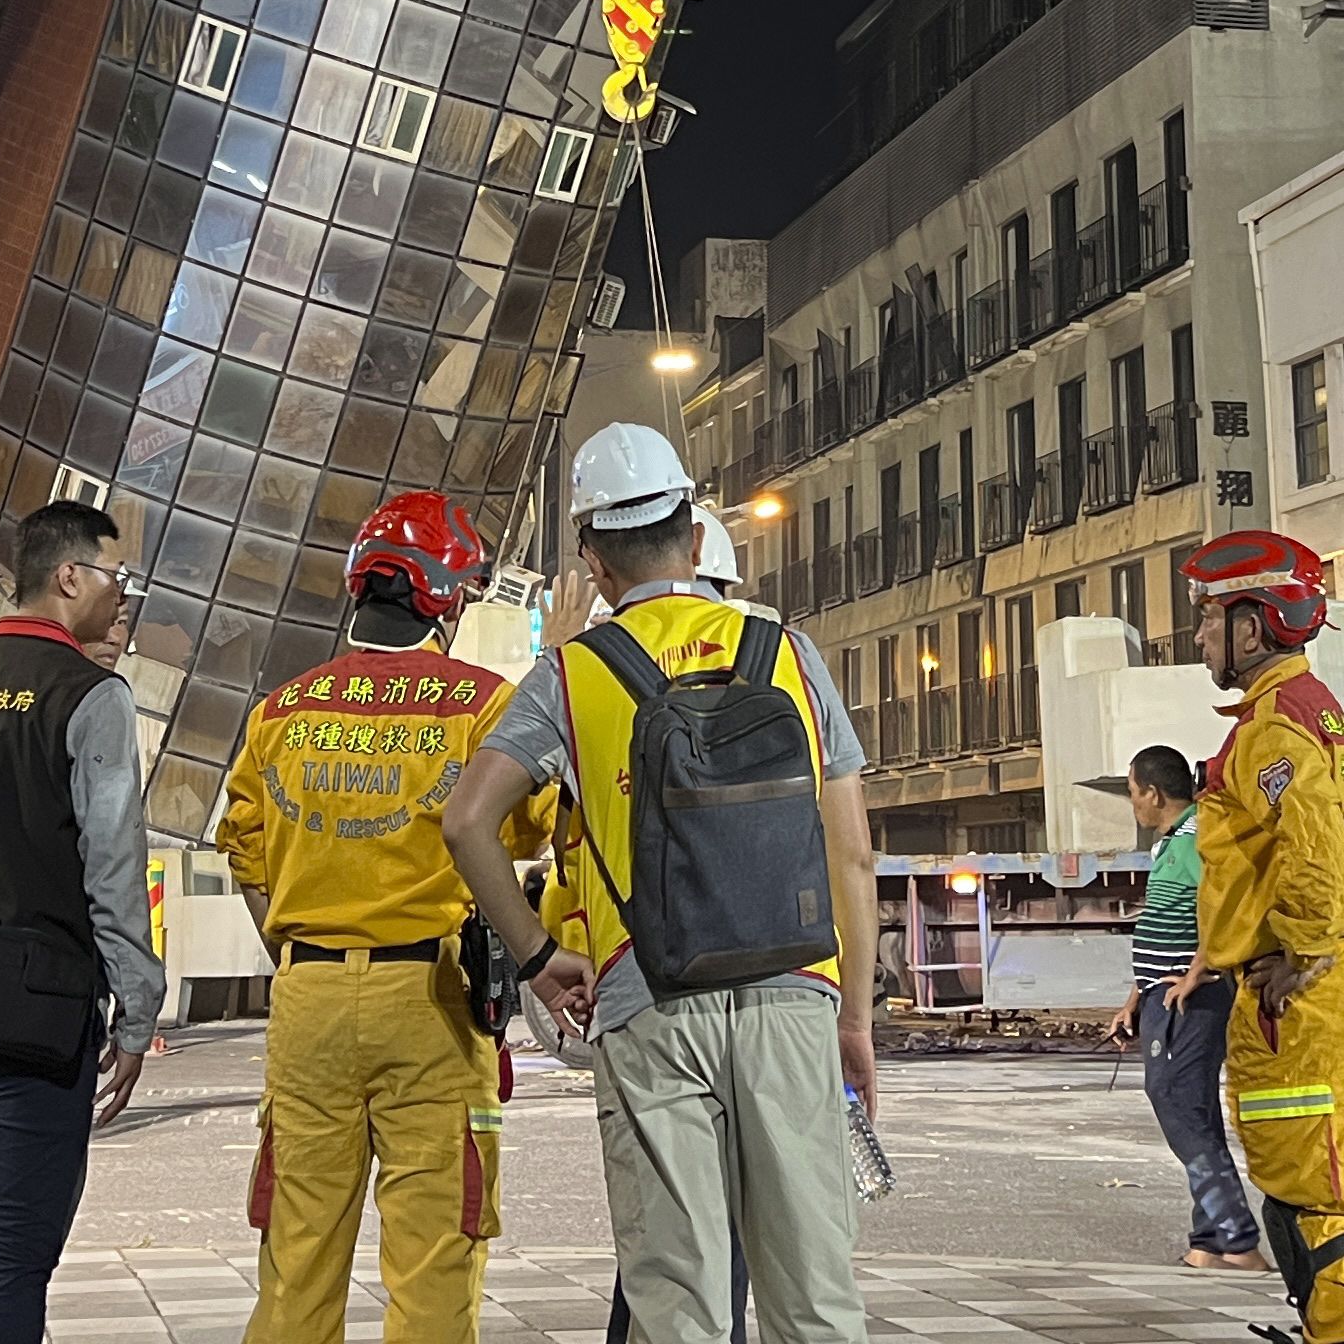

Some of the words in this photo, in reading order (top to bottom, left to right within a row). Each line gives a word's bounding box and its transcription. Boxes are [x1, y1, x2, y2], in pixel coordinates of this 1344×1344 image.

[276, 675, 478, 709] 花蓮縣消防局
[284, 720, 449, 755] 特種搜救隊
[302, 761, 402, 795] TAIWAN
[336, 805, 412, 839] RESCUE
[416, 760, 463, 811] TEAM
